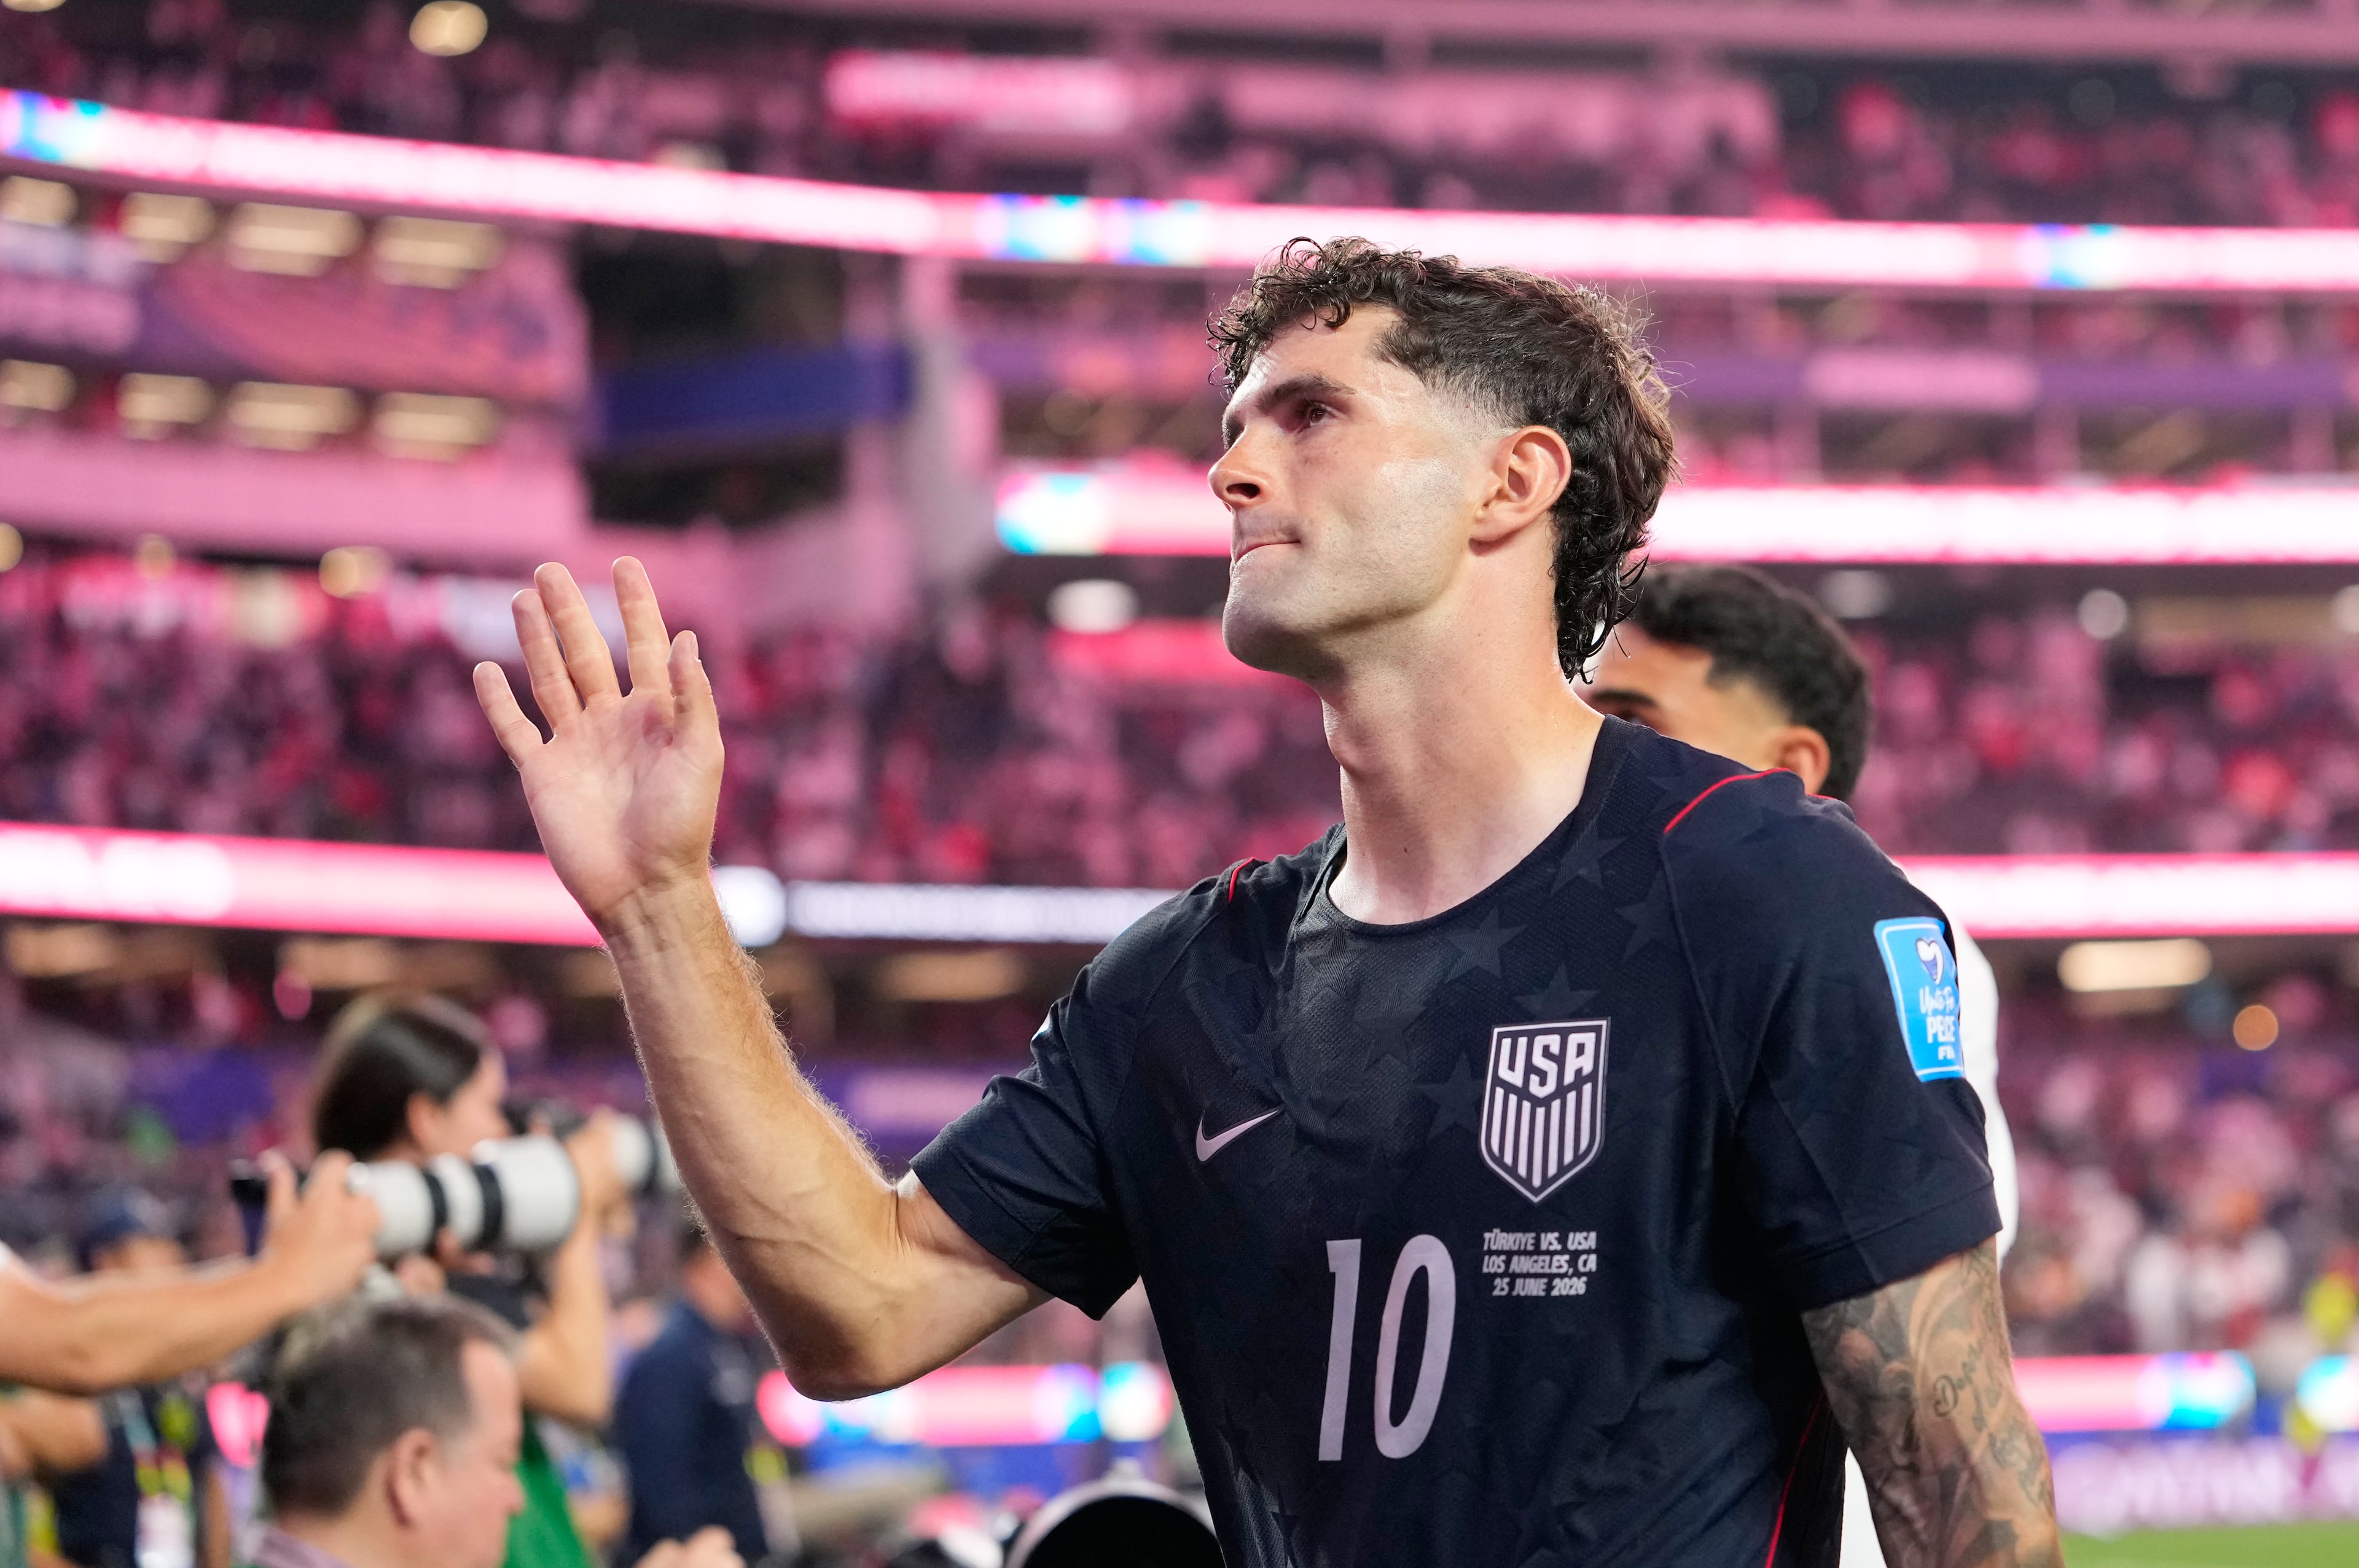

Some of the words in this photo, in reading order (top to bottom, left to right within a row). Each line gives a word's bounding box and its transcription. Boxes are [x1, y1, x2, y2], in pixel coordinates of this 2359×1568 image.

[1497, 1032, 1597, 1099] USA
[1540, 1231, 1562, 1251] VS.
[1567, 1231, 1597, 1250] USA
[1482, 1255, 1505, 1274] LOS
[1509, 1254, 1574, 1276] ANGELES,
[1577, 1254, 1597, 1273] CA
[1492, 1279, 1508, 1297] 25
[1512, 1279, 1547, 1297] JUNE
[1551, 1277, 1587, 1297] 2026
[1318, 1234, 1456, 1461] 10
